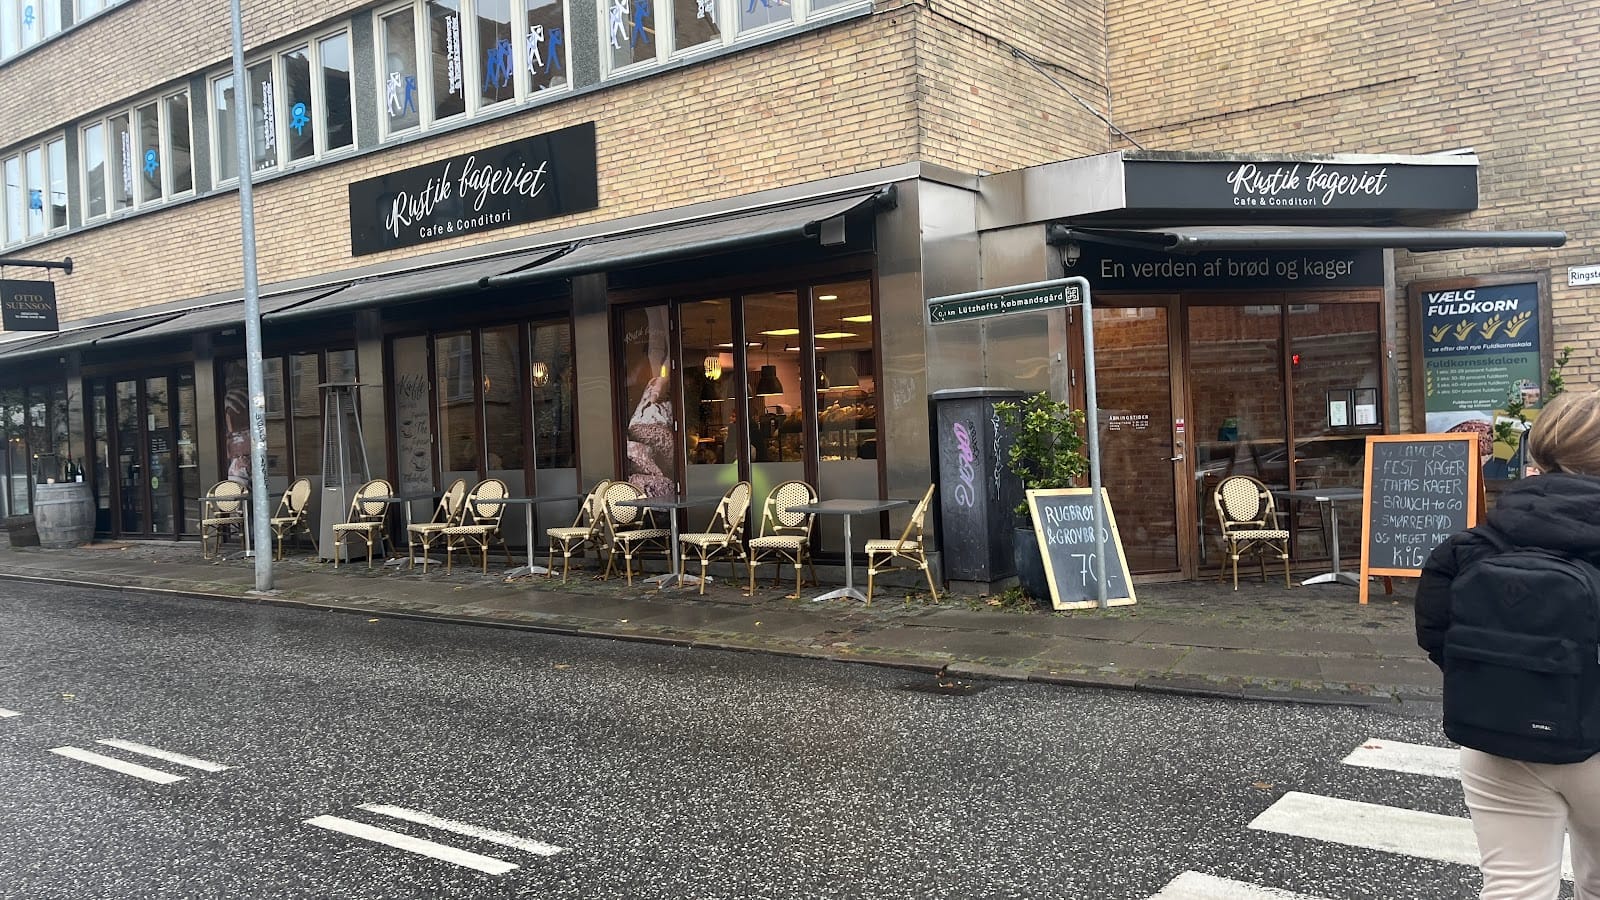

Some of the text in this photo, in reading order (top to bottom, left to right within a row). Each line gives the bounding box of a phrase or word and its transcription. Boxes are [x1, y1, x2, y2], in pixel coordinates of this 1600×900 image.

[1227, 163, 1300, 195] Rustik
[386, 162, 451, 238] Rustik
[1233, 197, 1317, 206] Cafe & Conditori
[419, 209, 511, 239] Cafe & Conditori
[1100, 257, 1355, 280] En verden af brød og kager
[14, 294, 43, 302] OTTO
[1000, 291, 1064, 308] Købmandsgård
[1428, 289, 1476, 303] VÆLG
[1427, 299, 1519, 317] FULDKORN
[1426, 356, 1528, 368] Fuldkornsskalaen
[1383, 459, 1467, 476] FEST KAGER
[1380, 478, 1464, 495] TAPAS KAGER
[1383, 495, 1430, 511] BRUNCH
[1446, 498, 1462, 510] GO
[1394, 532, 1427, 544] MEGET
